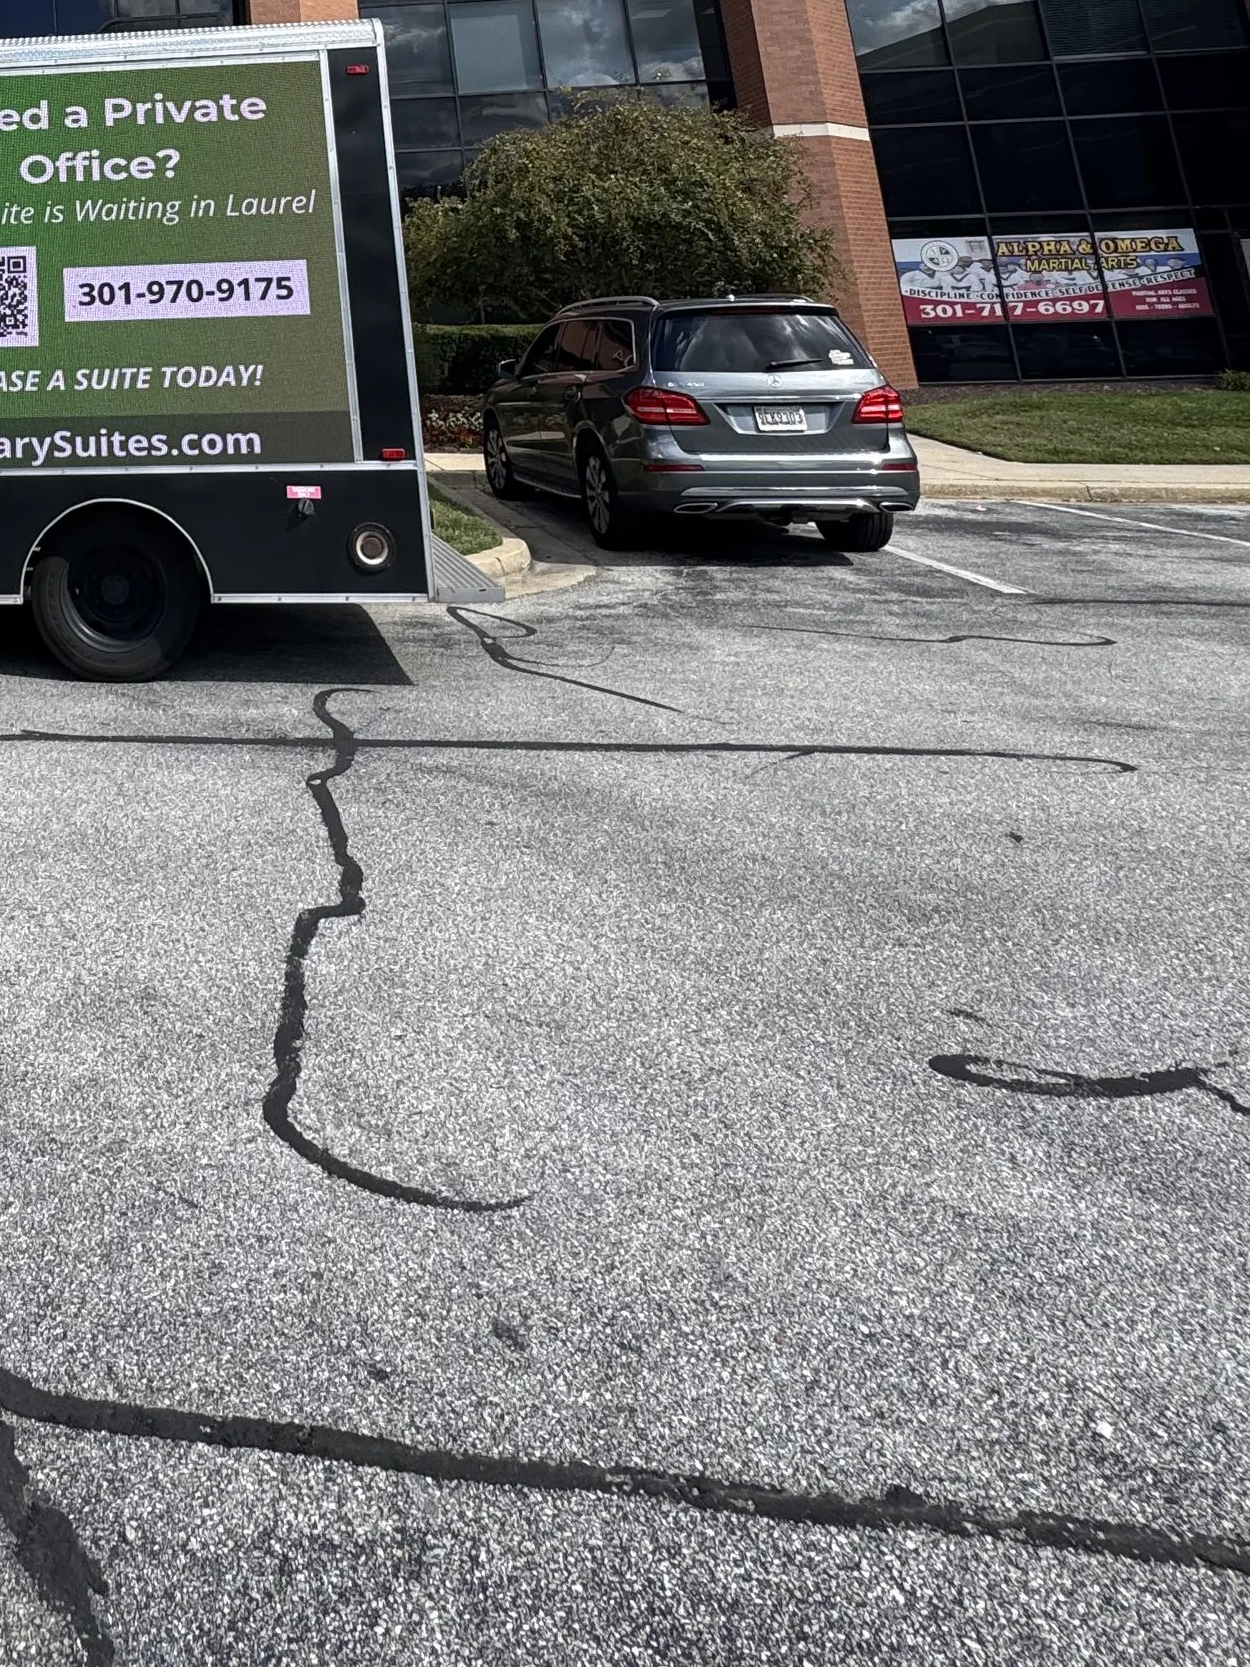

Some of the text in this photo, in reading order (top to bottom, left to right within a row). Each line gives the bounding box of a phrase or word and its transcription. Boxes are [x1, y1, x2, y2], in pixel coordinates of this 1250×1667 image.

[64, 105, 88, 129] a
[104, 93, 267, 127] Private
[20, 148, 181, 184] Office?
[44, 200, 64, 224] is
[75, 194, 181, 225] Waiting
[190, 194, 215, 217] in
[226, 189, 316, 217] Laurel
[996, 236, 1185, 257] ALPHA & OMEGA
[1025, 255, 1138, 272] MARTIAL ARTS
[78, 276, 294, 306] 301-970-9175
[909, 288, 973, 300] DISCIPLINE
[919, 299, 1105, 318] 301-717-6697
[47, 368, 66, 391] A
[73, 367, 153, 390] SUITE
[161, 365, 264, 388] TODAY!
